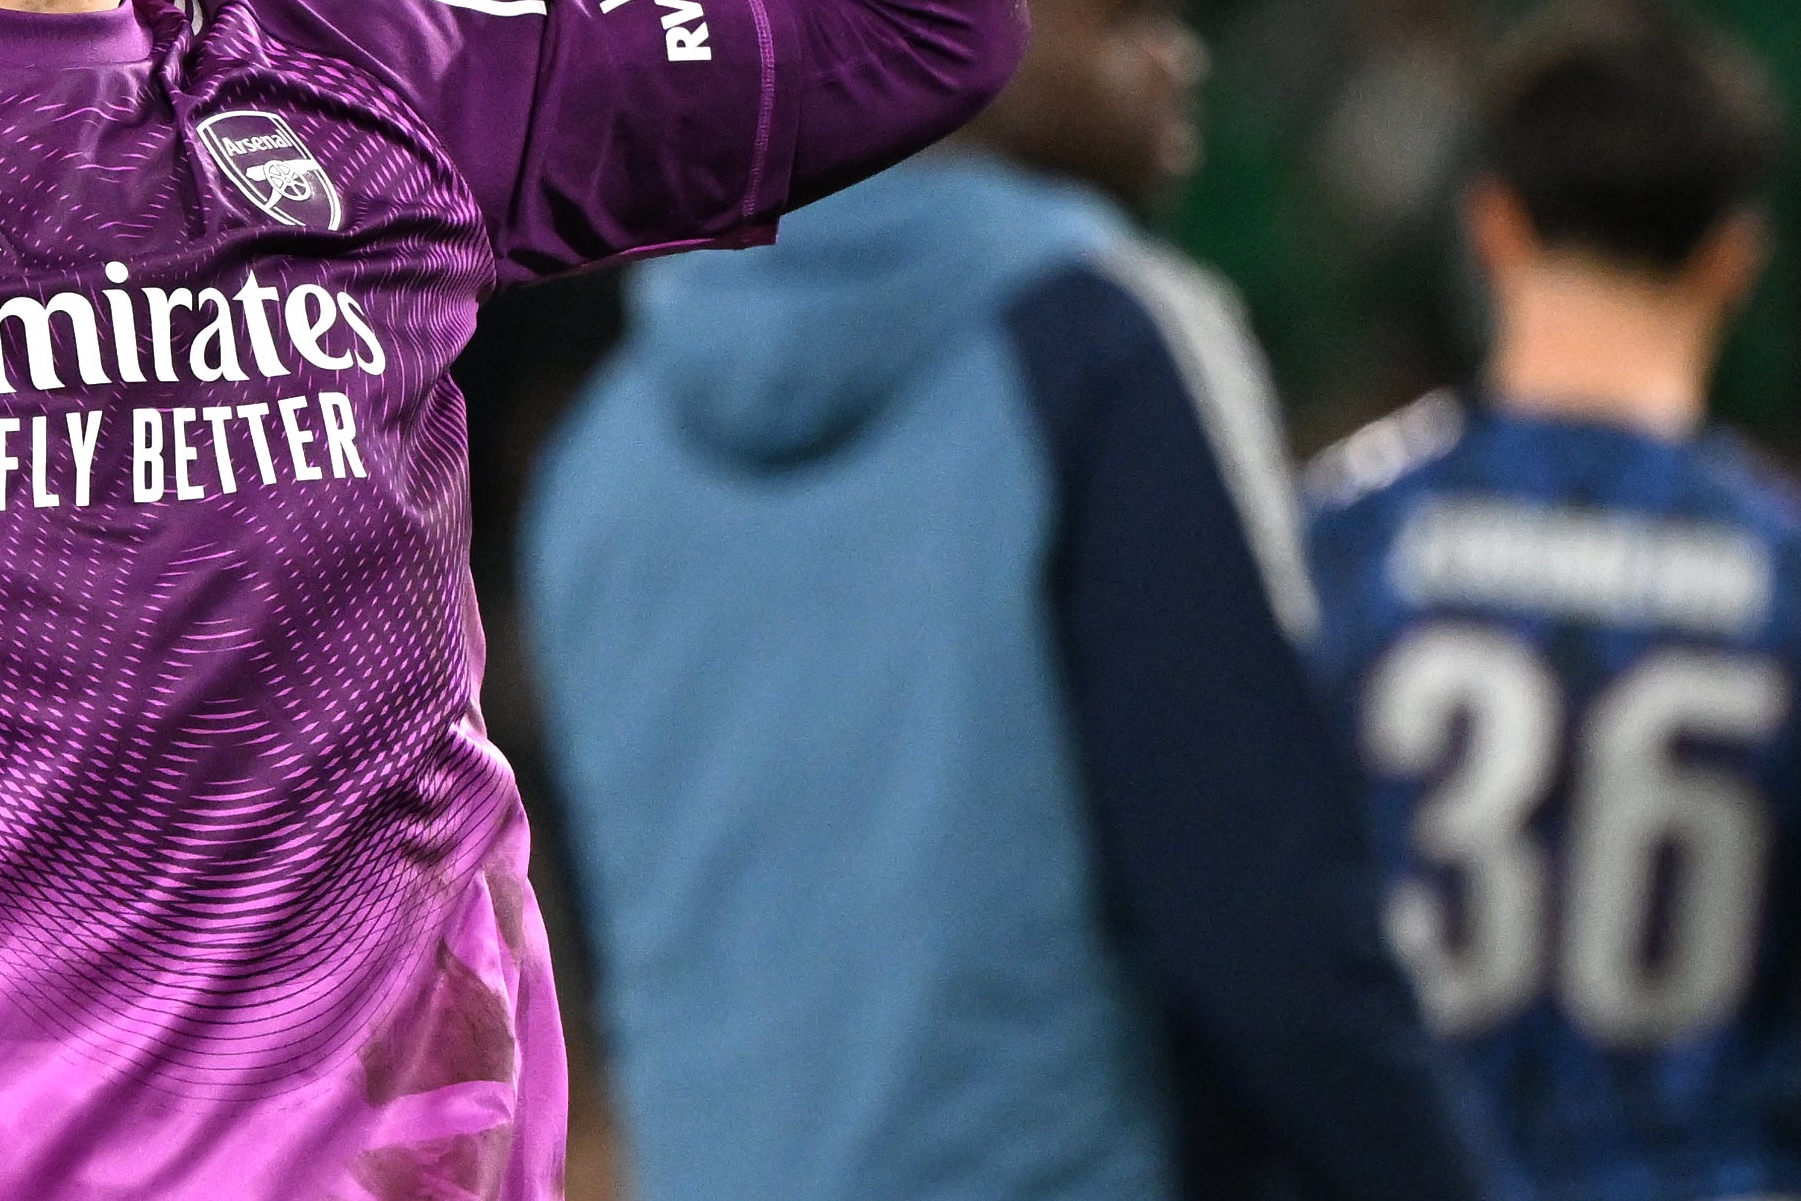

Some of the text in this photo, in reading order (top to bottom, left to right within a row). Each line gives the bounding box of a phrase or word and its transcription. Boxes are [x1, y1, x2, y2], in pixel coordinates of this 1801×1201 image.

[222, 129, 293, 157] Arsenal
[132, 391, 367, 503] BETTER
[1356, 618, 1792, 1050] 36
